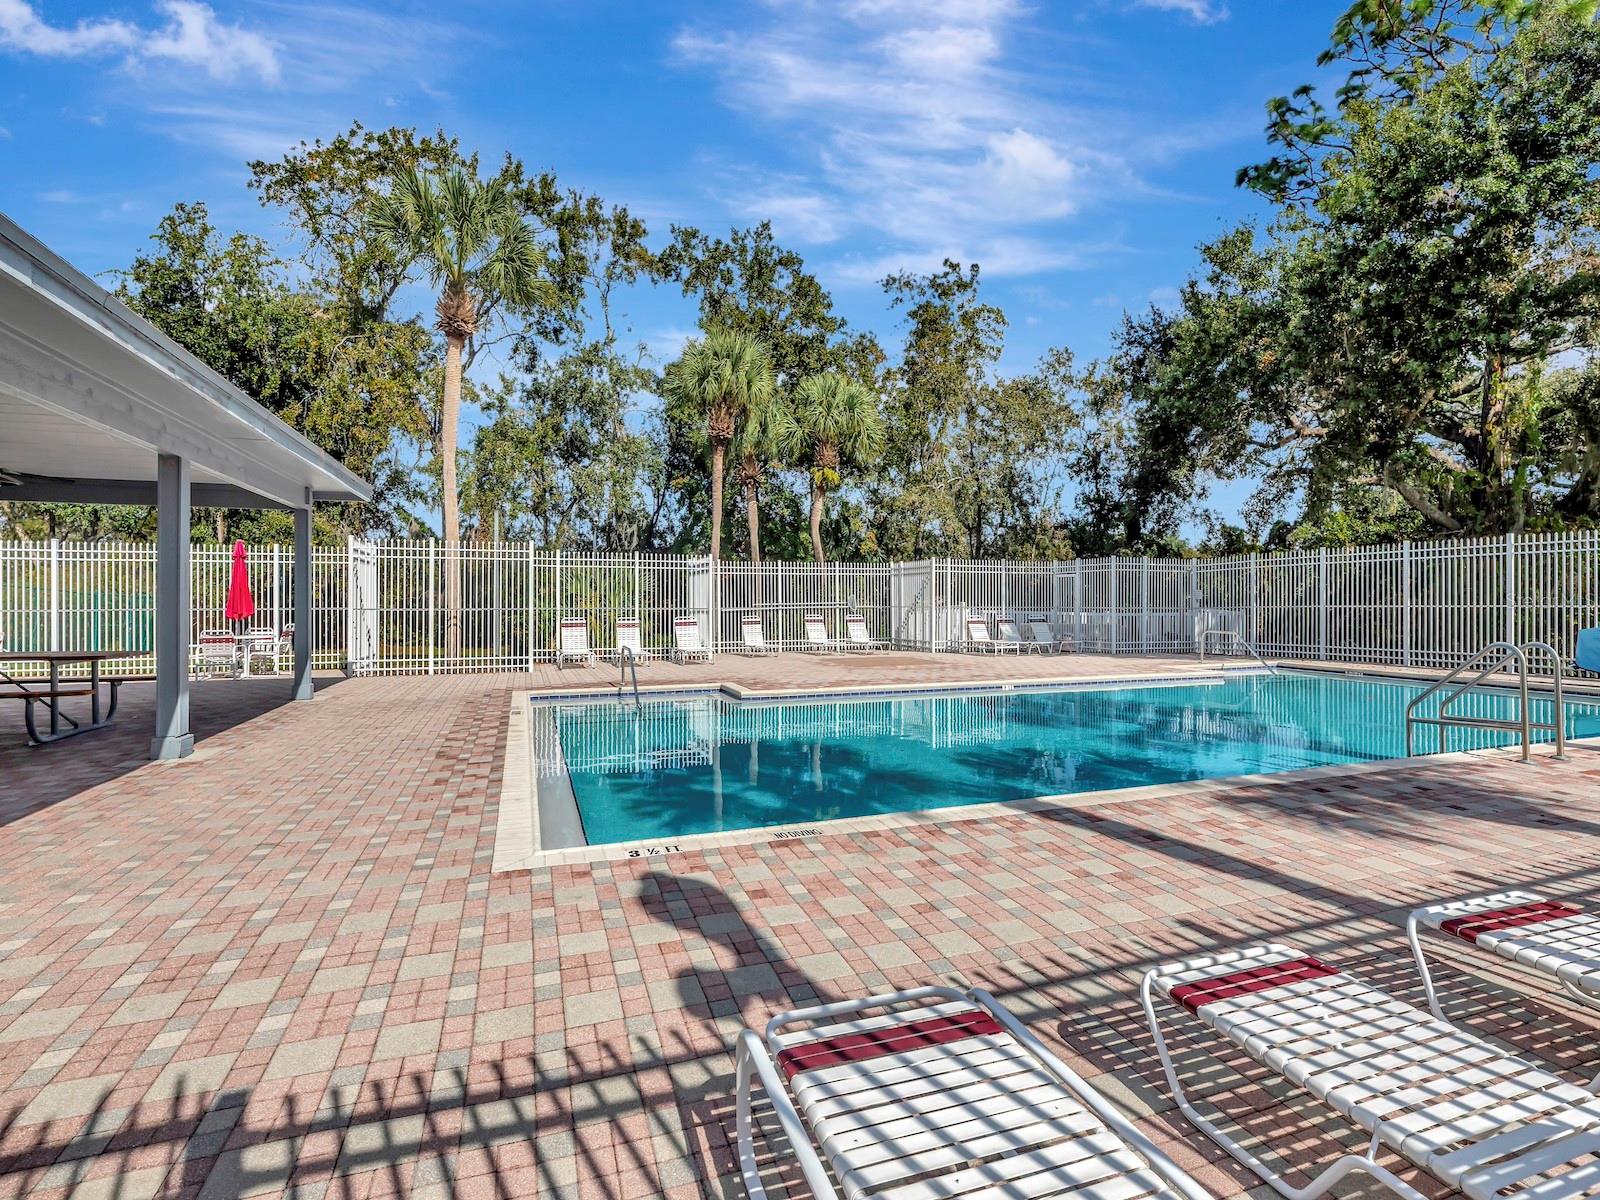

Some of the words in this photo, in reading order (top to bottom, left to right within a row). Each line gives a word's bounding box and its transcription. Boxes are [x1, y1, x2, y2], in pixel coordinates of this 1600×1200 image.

[773, 831, 789, 839] NO
[787, 828, 823, 838] DIVING
[628, 850, 641, 858] 3
